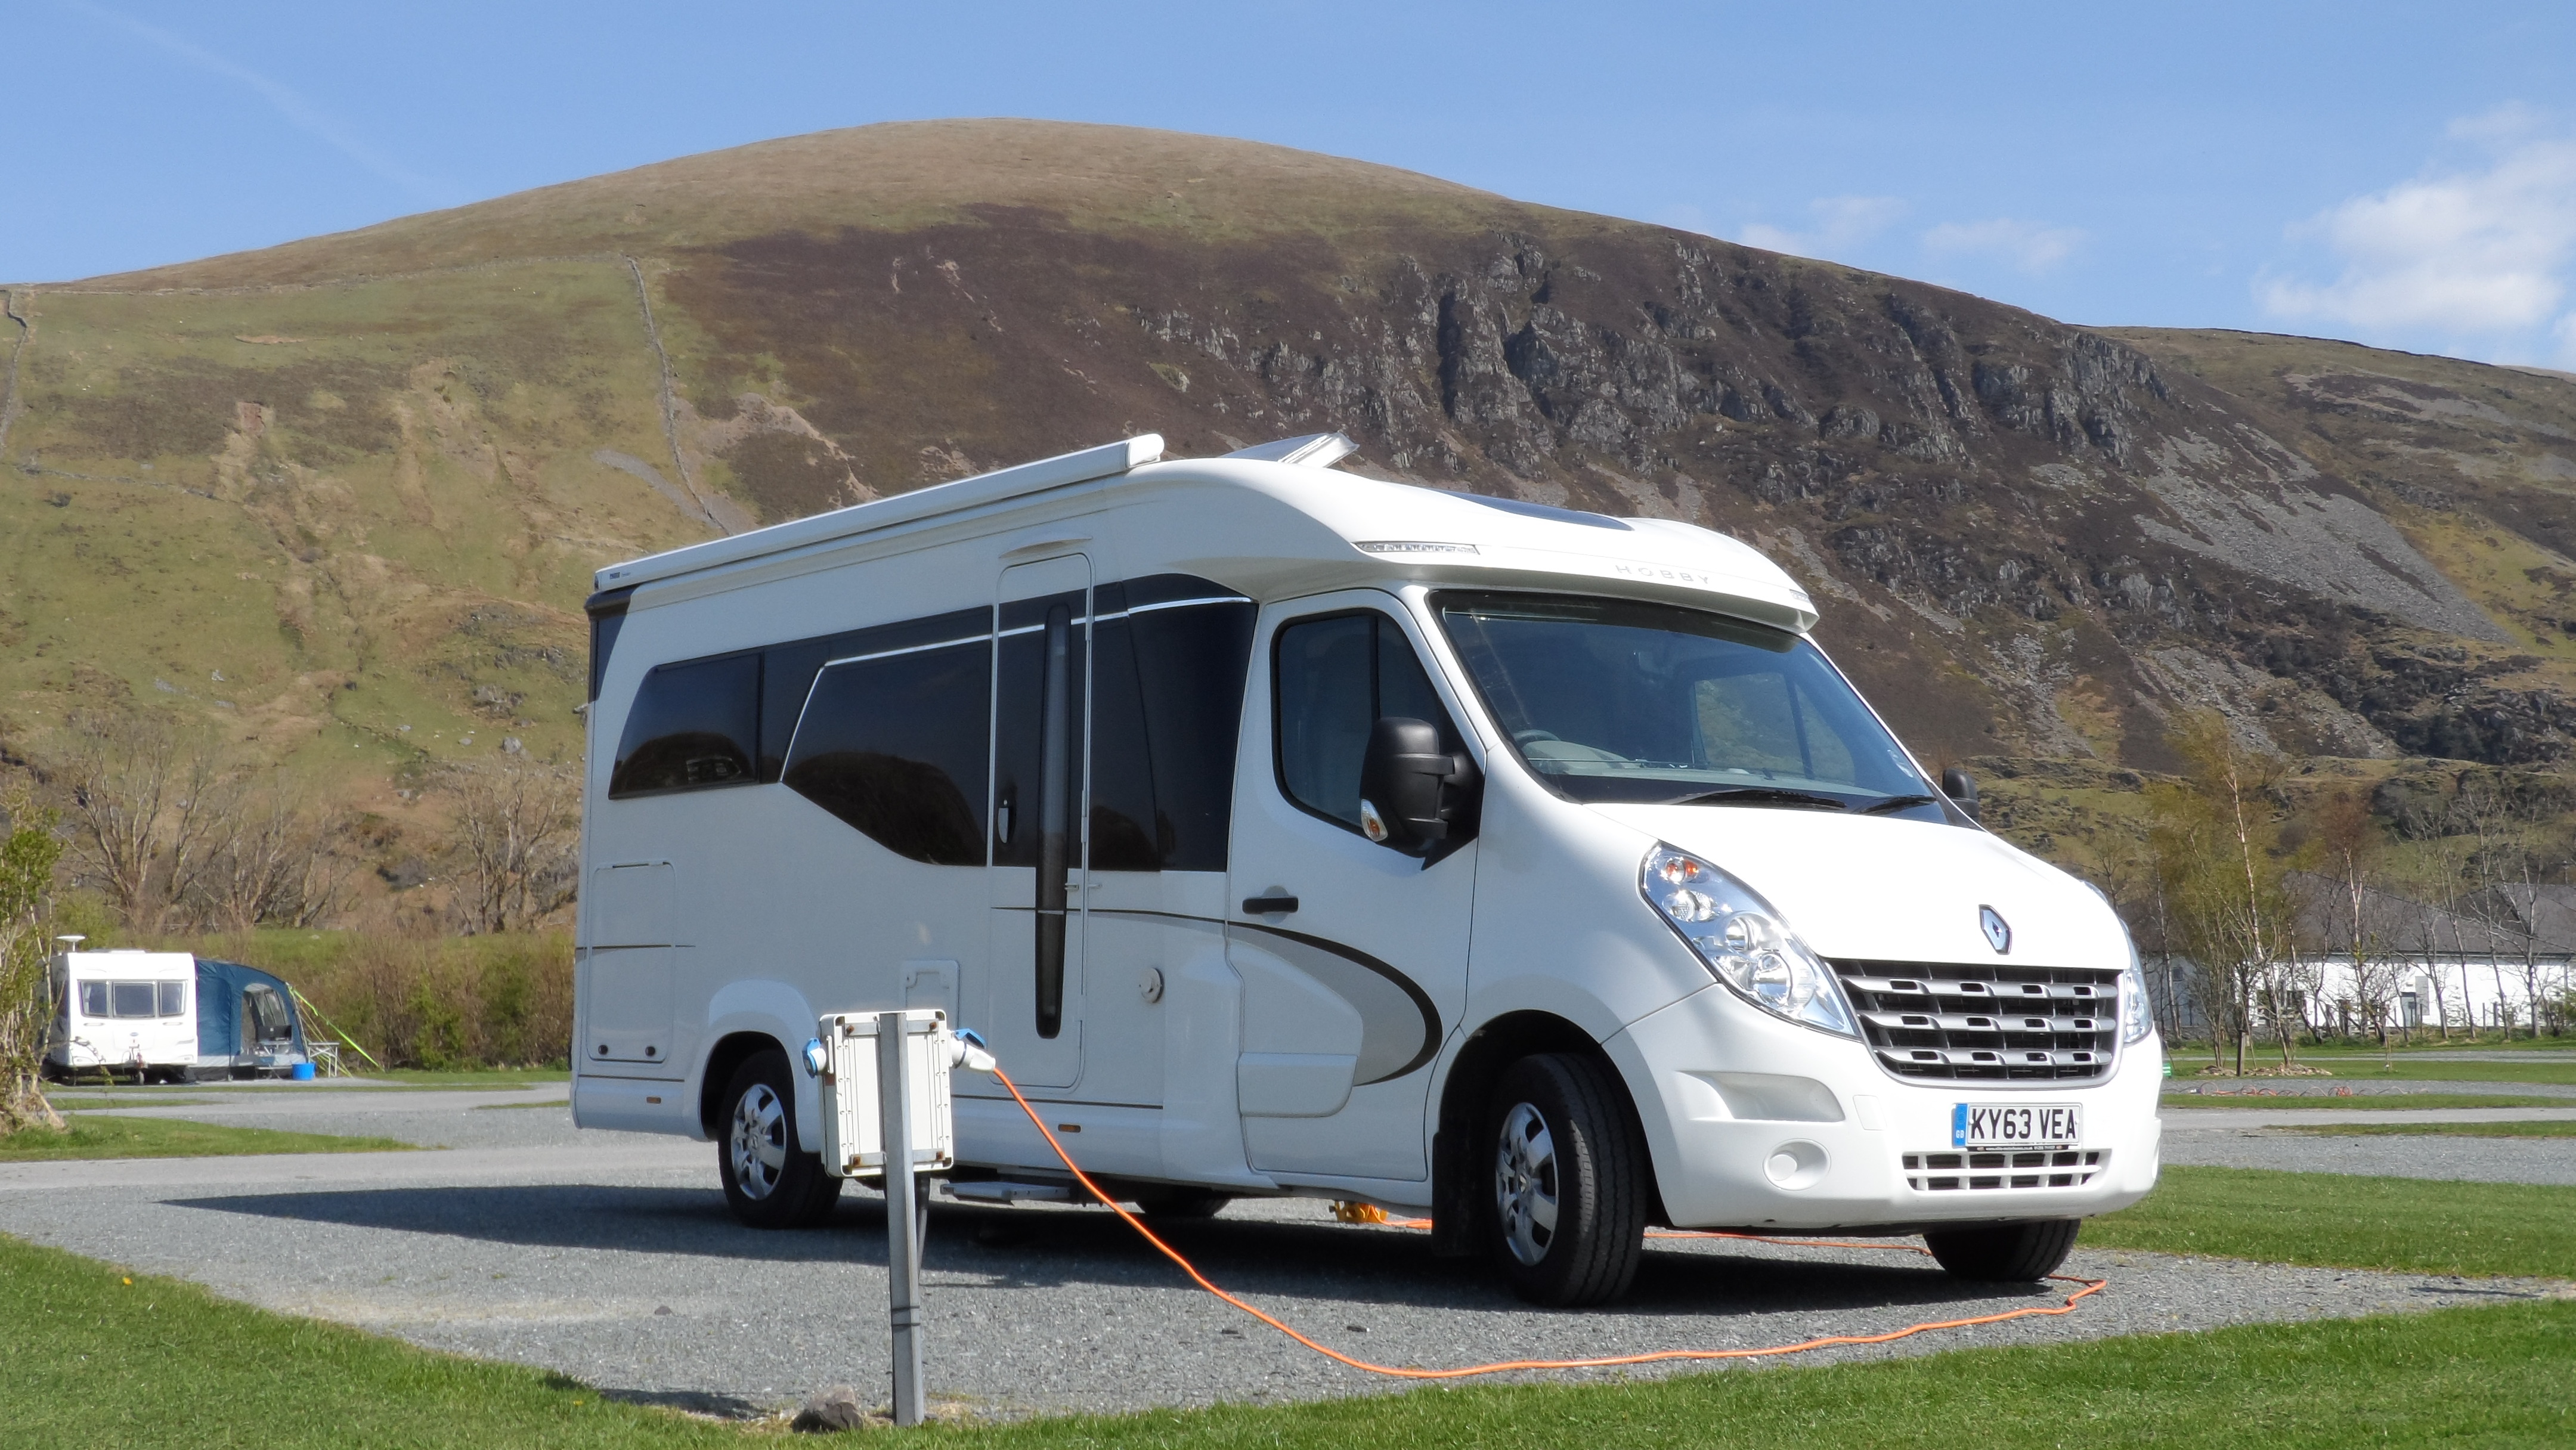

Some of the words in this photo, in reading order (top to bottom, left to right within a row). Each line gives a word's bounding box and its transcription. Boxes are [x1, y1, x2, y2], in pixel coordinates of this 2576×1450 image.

[1615, 565, 1708, 584] HOBBY
[1970, 1108, 2032, 1139] KY63
[2039, 1108, 2076, 1139] VEA
[1955, 1130, 1965, 1139] GB
